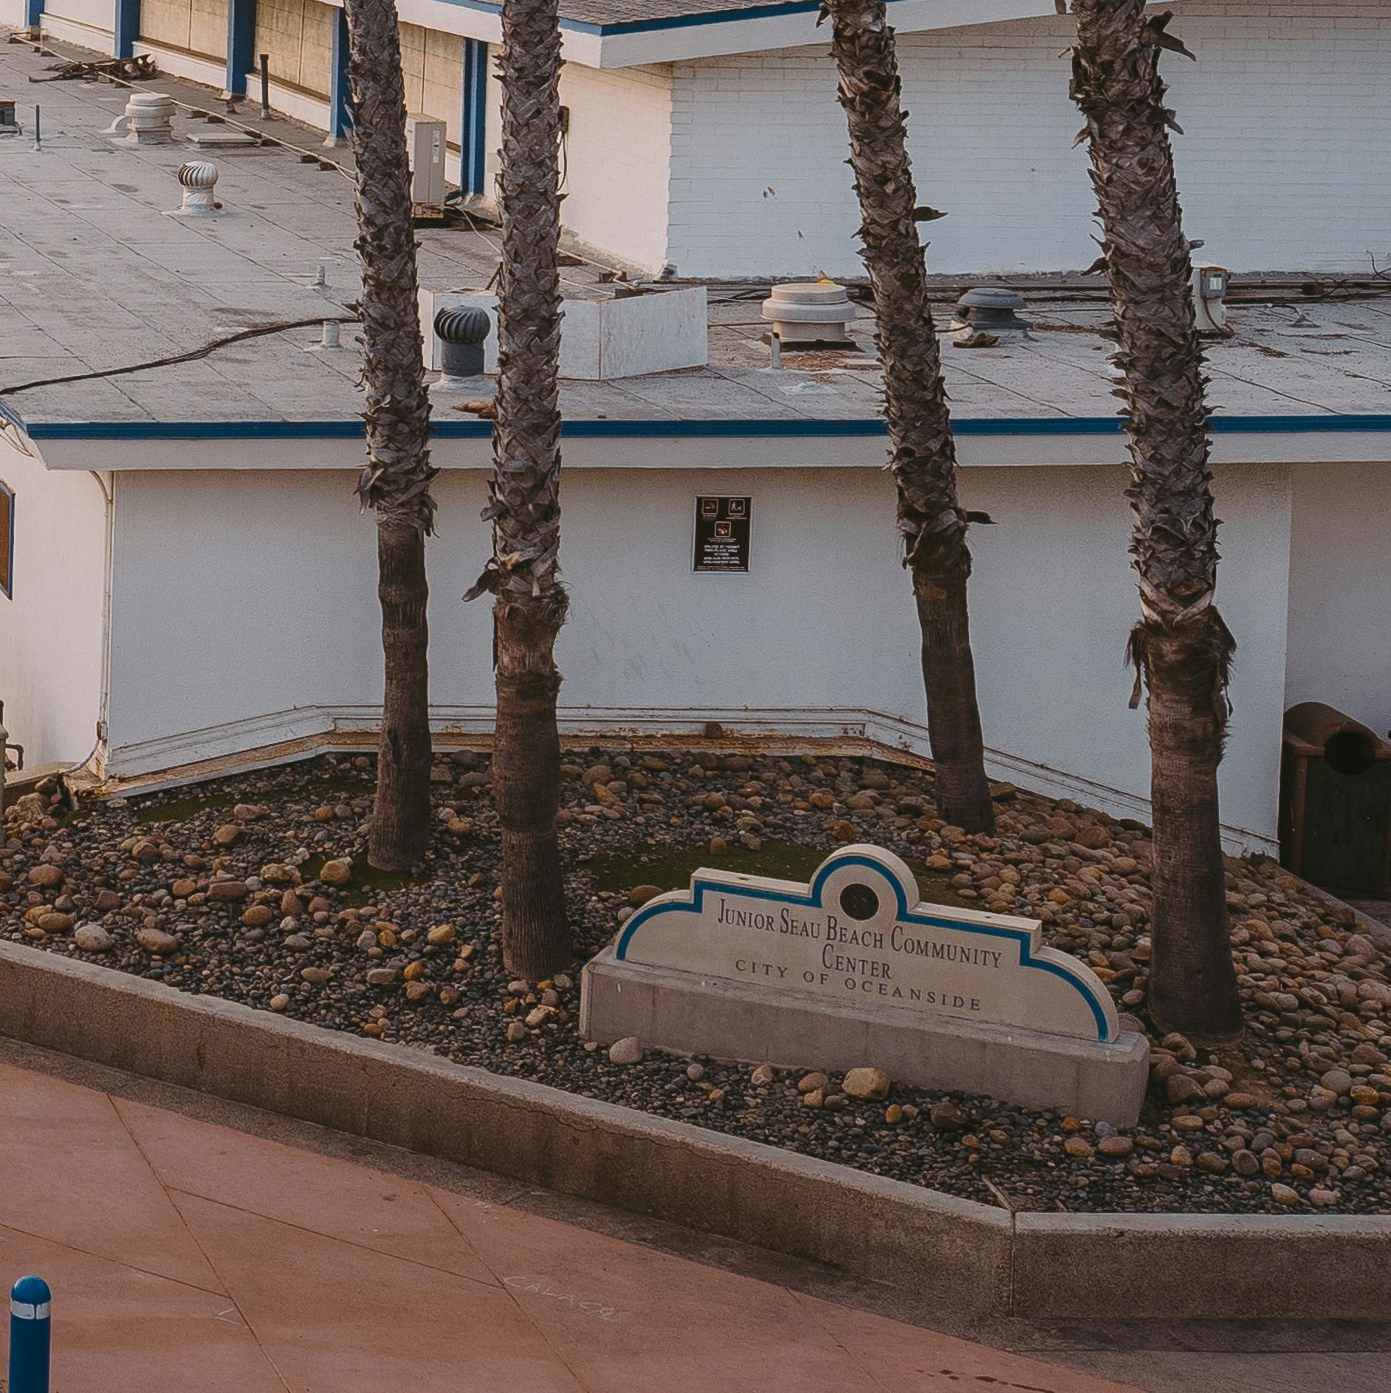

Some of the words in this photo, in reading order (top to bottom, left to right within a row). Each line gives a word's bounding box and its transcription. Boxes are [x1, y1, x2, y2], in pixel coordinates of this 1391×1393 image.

[718, 898, 775, 932] JUNIOR
[780, 908, 821, 939] SEAU
[826, 915, 884, 950] BEACH
[891, 925, 1003, 969] COMMUNITY
[735, 959, 789, 979] CITY
[803, 970, 830, 985] OF
[845, 977, 982, 1011] OCEANSIDE
[822, 944, 891, 980] CENTER
